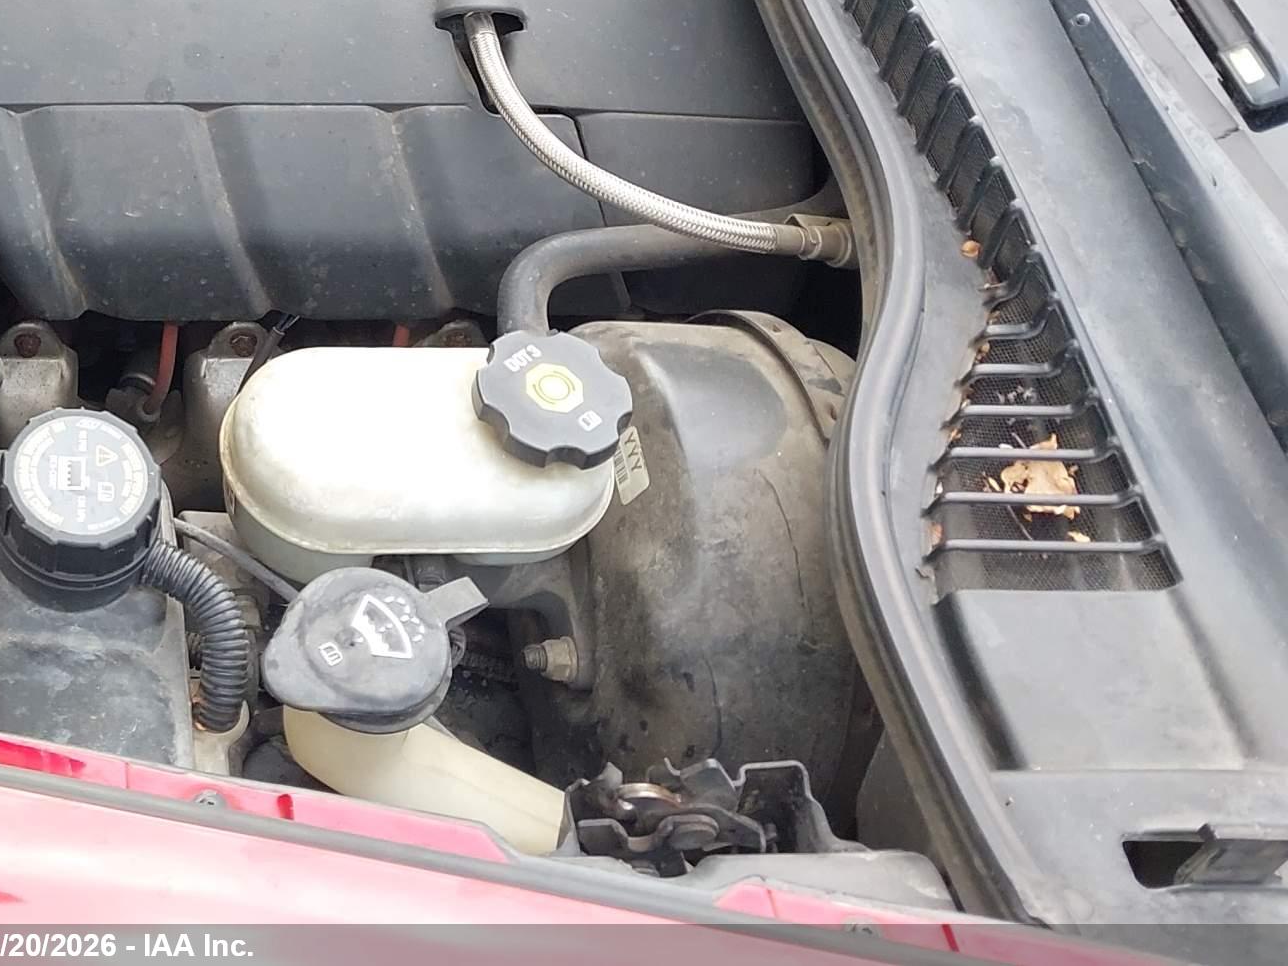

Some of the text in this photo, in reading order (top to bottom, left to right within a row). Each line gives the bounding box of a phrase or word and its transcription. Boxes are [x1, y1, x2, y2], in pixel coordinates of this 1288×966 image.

[503, 344, 542, 372] DOT 3
[624, 431, 642, 472] YYY
